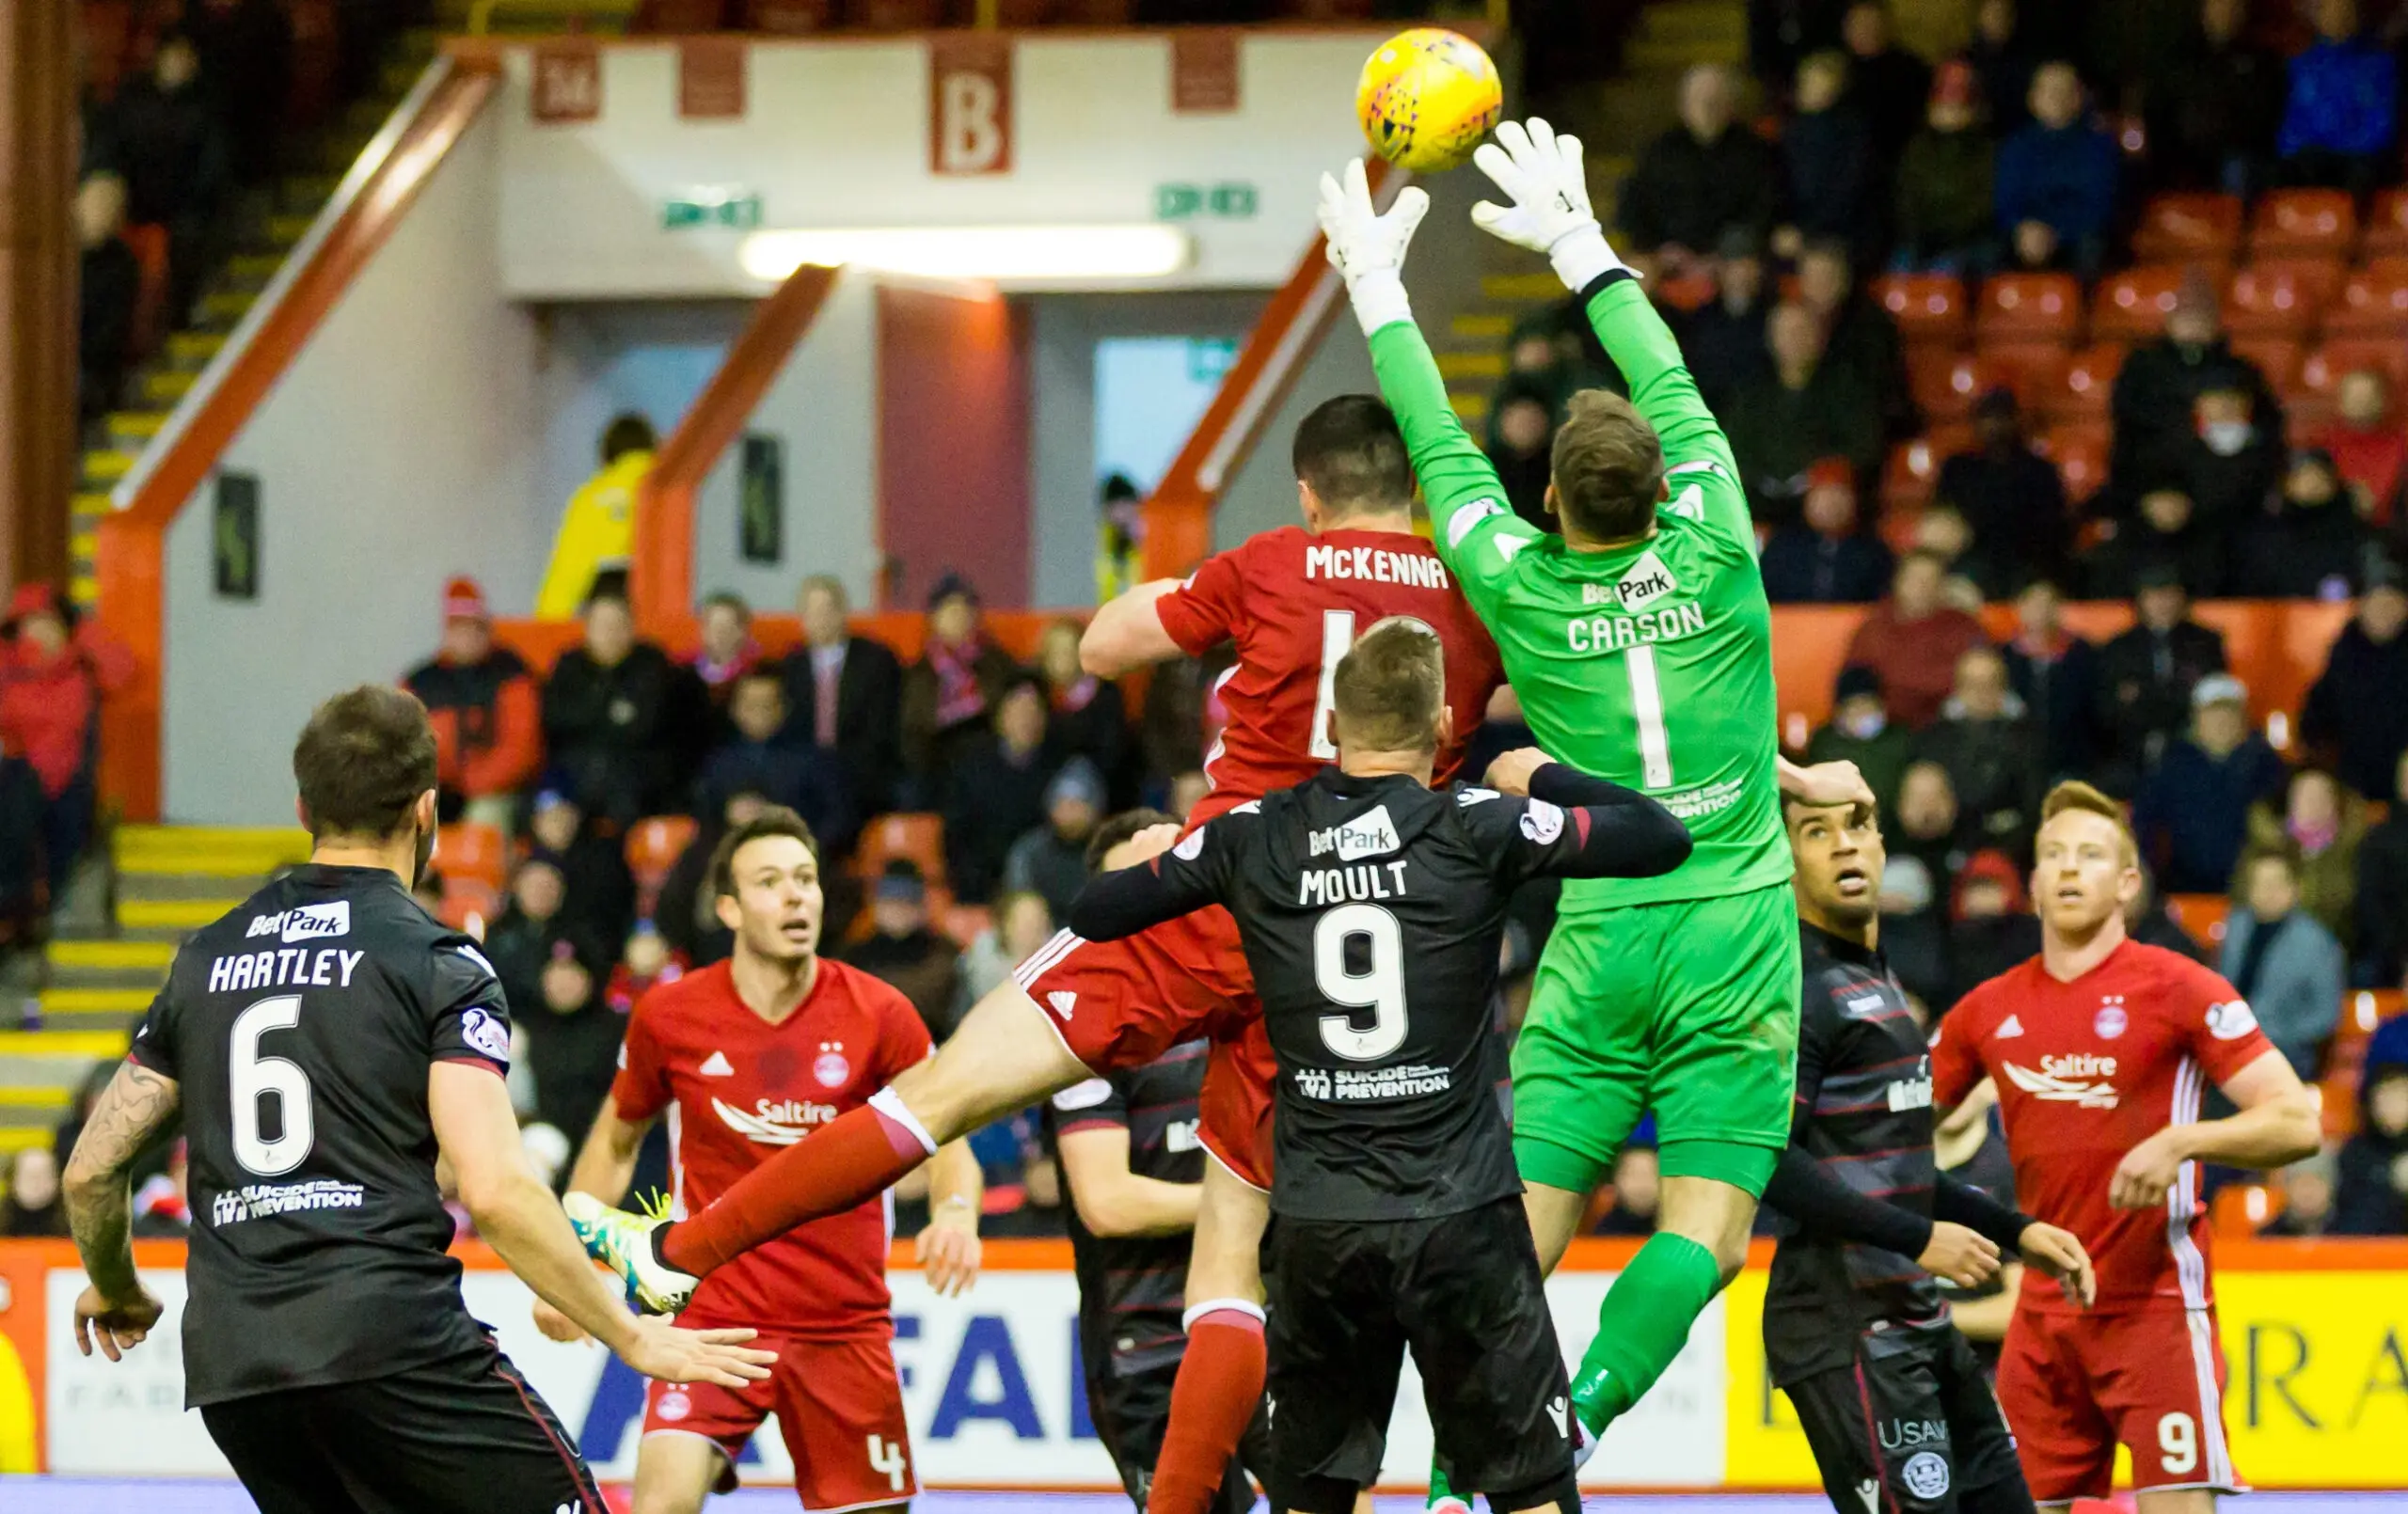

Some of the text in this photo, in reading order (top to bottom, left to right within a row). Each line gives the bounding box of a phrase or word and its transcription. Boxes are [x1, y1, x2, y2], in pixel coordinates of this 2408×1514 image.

[943, 71, 1001, 170] B
[1568, 601, 1706, 651] CARSON
[1625, 644, 1672, 788] 1
[1299, 860, 1408, 905] MOULT
[209, 949, 365, 993] HARTLEY
[1314, 901, 1409, 1062] 9
[229, 994, 314, 1176] 6
[1335, 1065, 1408, 1084] SUICIDE
[2039, 1052, 2117, 1077] Saltire
[1336, 1075, 1450, 1100] PREVENTION
[755, 1098, 837, 1124] Saltire
[242, 1181, 316, 1204] SUICIDE
[248, 1191, 363, 1219] PREVENTION
[866, 1433, 907, 1492] 4
[2158, 1411, 2197, 1475] 9
